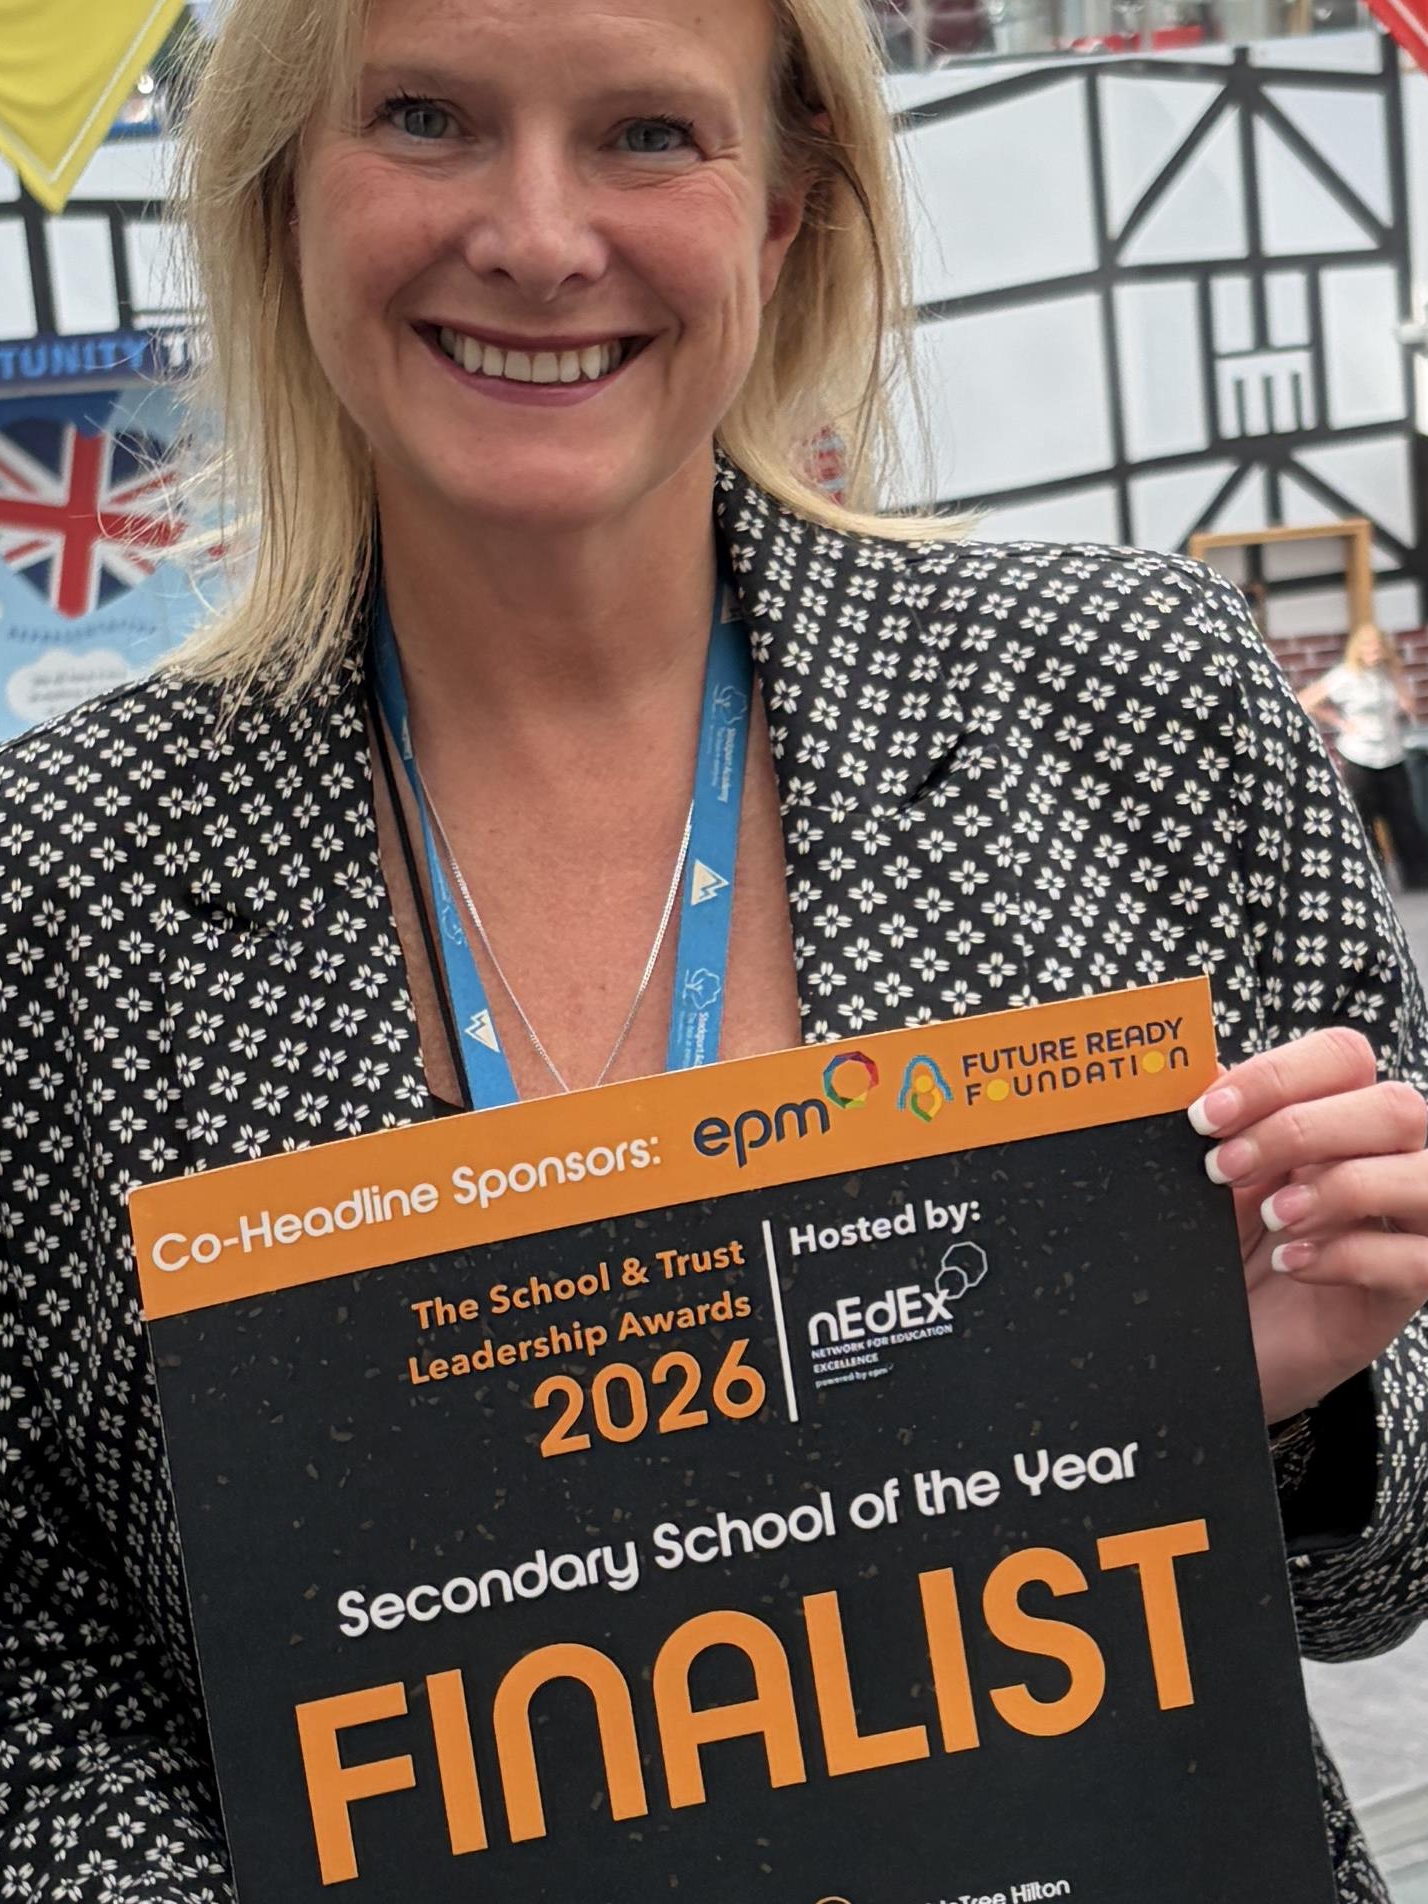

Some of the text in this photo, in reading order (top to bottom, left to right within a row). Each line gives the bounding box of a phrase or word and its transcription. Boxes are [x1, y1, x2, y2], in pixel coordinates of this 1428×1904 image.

[962, 1017, 1184, 1078] FUTURE READY
[693, 1098, 831, 1169] epm
[151, 1136, 662, 1272] Co-Headline Sponsors:
[789, 1199, 981, 1255] Hosted by:
[411, 1240, 746, 1330] The School & Trust
[808, 1284, 954, 1346] nEdEx
[408, 1291, 752, 1385] Leadership Awards
[811, 1324, 953, 1359] NETWORK FOR EDUCATION
[813, 1352, 879, 1374] EXCELLENCE
[533, 1338, 766, 1459] 2026
[337, 1441, 1140, 1637] Secondary School of the Year
[294, 1518, 1210, 1887] FINALIST
